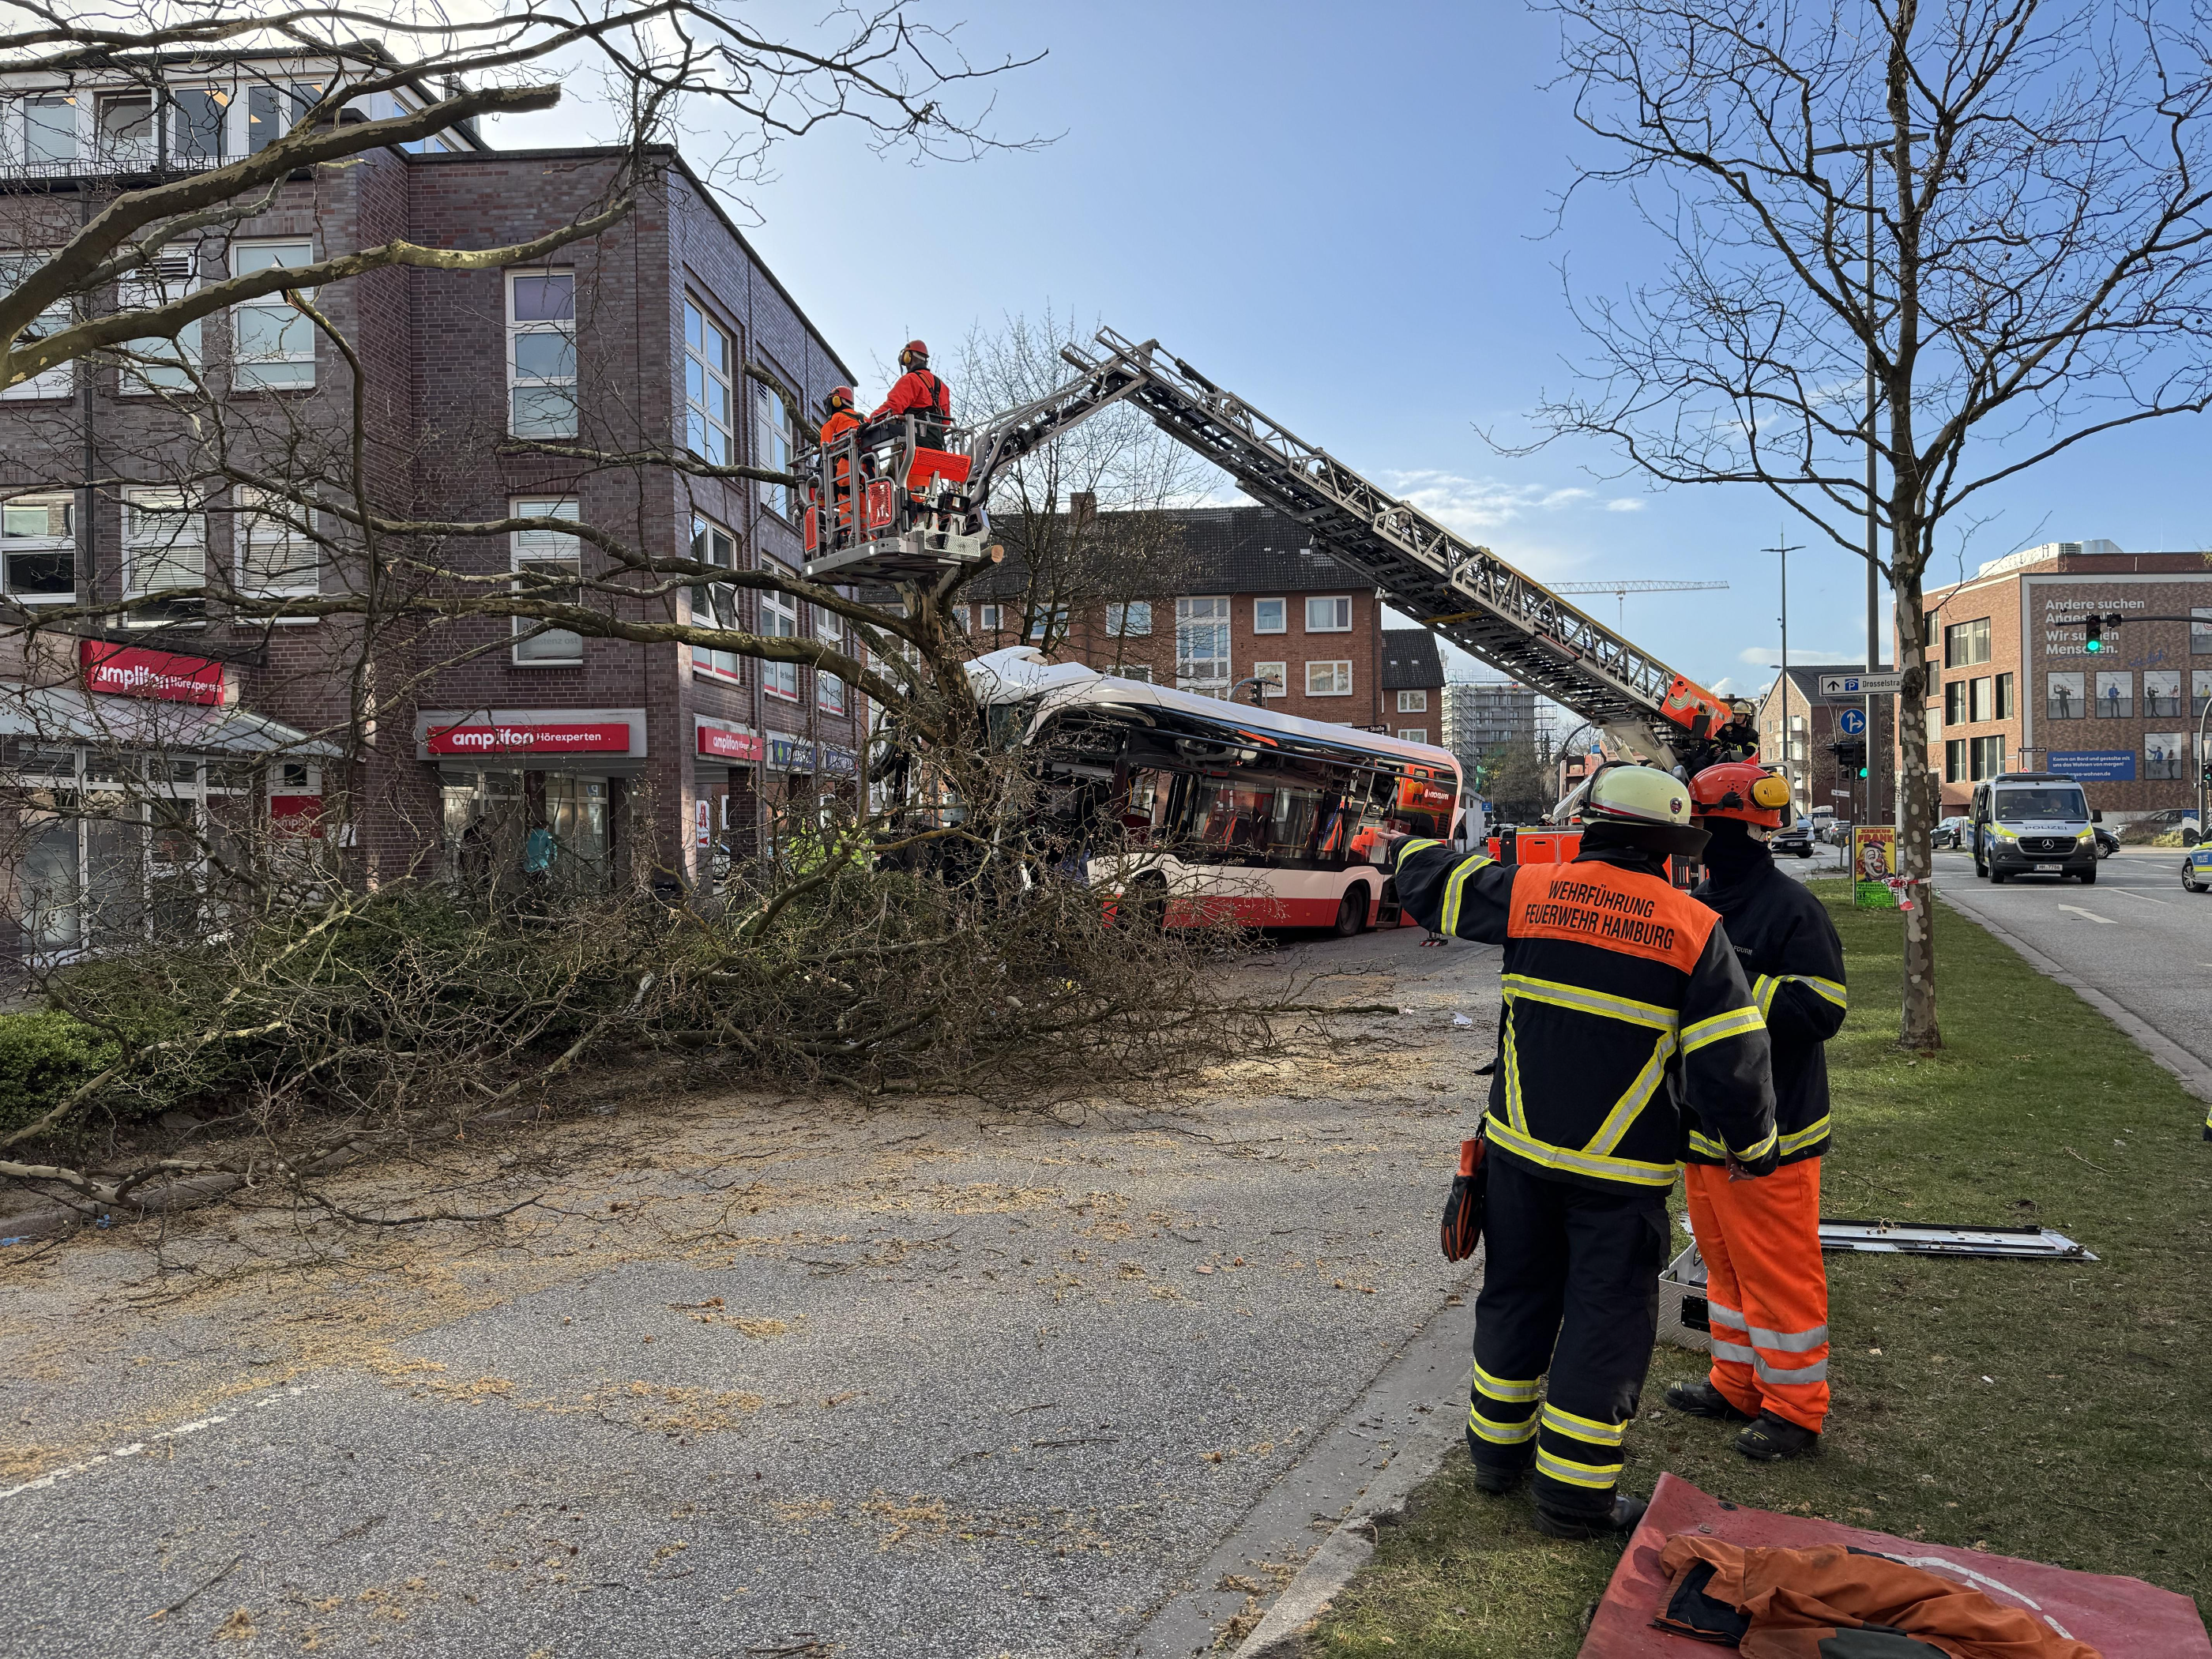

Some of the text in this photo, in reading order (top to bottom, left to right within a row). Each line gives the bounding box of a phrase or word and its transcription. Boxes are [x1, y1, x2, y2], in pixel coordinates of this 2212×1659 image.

[2045, 598, 2145, 610] Andere suchen
[2045, 630, 2068, 641] Wir
[2045, 644, 2119, 655] Menscen.
[95, 664, 170, 690] amplifon
[1862, 679, 1901, 688] Drosselstra
[536, 732, 602, 746] Hörexperten
[713, 734, 739, 753] amplifon
[1857, 833, 1894, 844] FRANK
[1548, 879, 1655, 919] WEHRFÜHRUNG
[1525, 904, 1675, 950] FEUERWEHR HAMBURG
